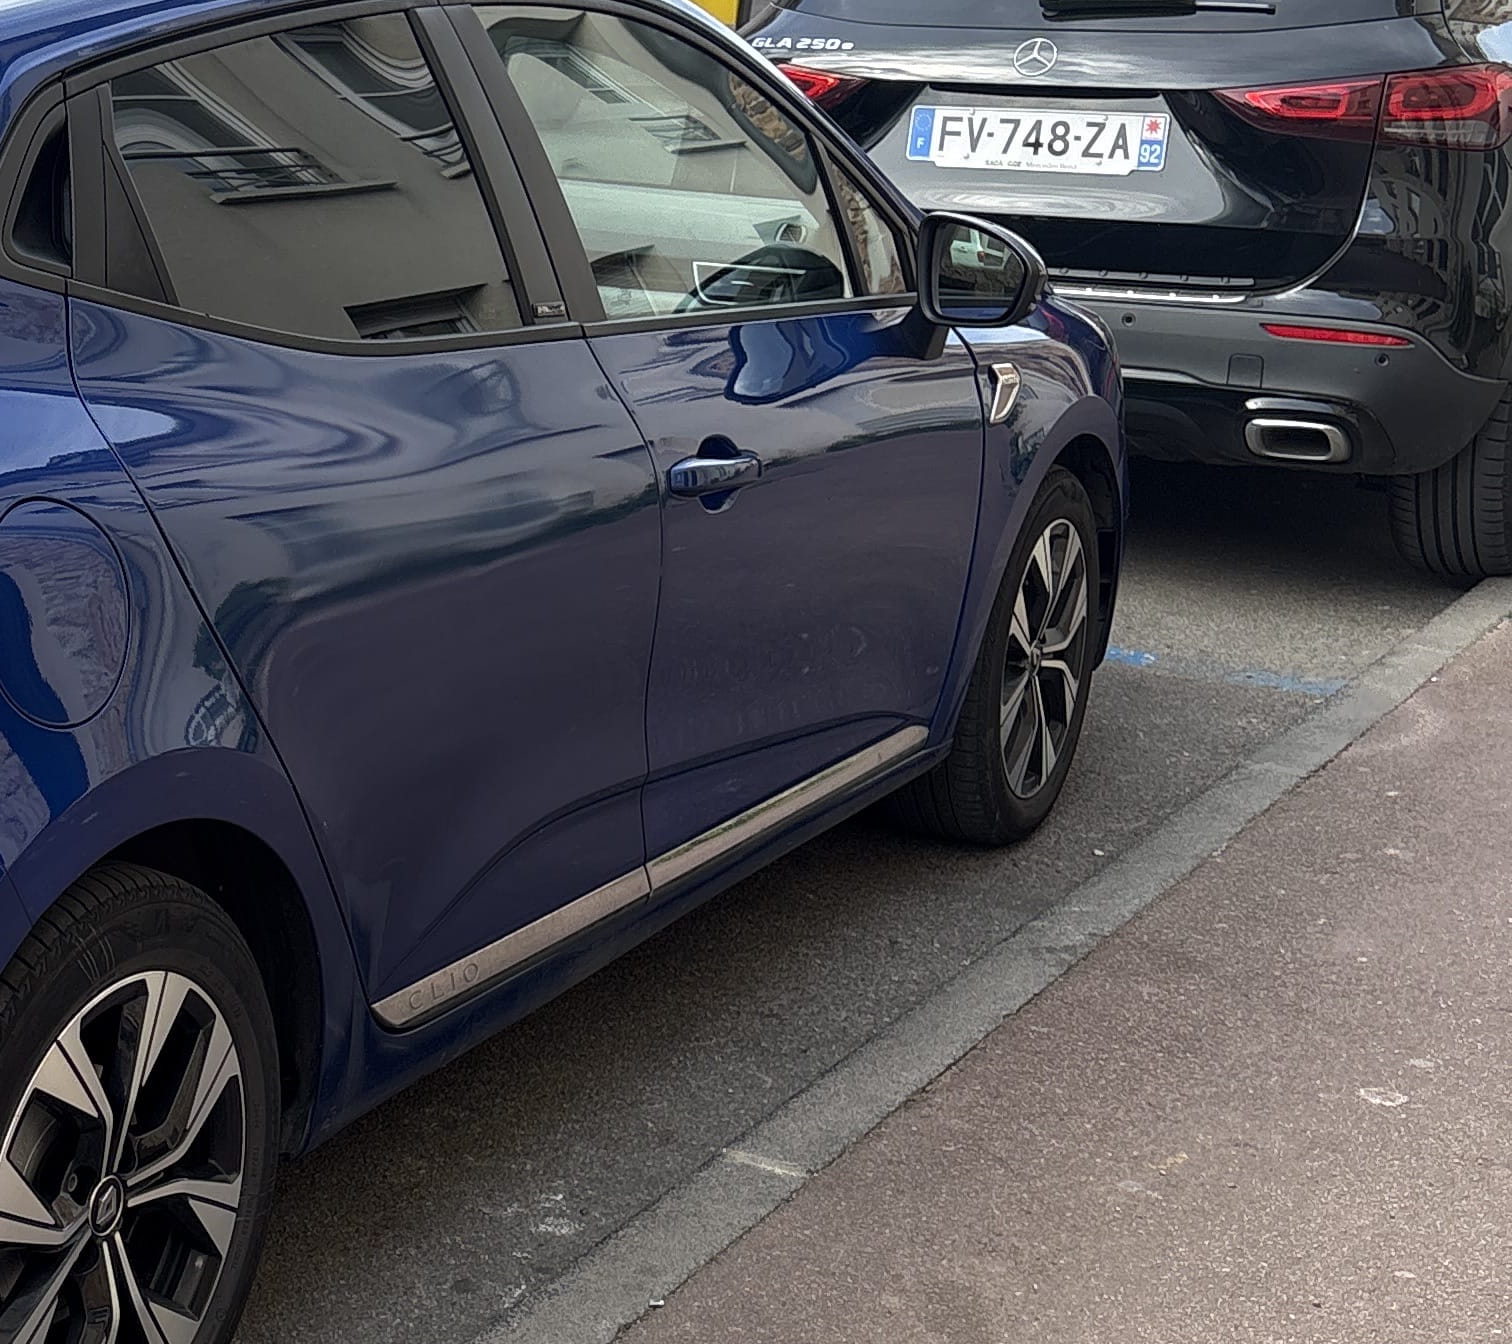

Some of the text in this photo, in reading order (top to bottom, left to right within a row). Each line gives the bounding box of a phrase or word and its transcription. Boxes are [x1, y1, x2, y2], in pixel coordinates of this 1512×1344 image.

[751, 37, 792, 49] GLA
[916, 115, 1161, 164] F FV-748-ZA 92
